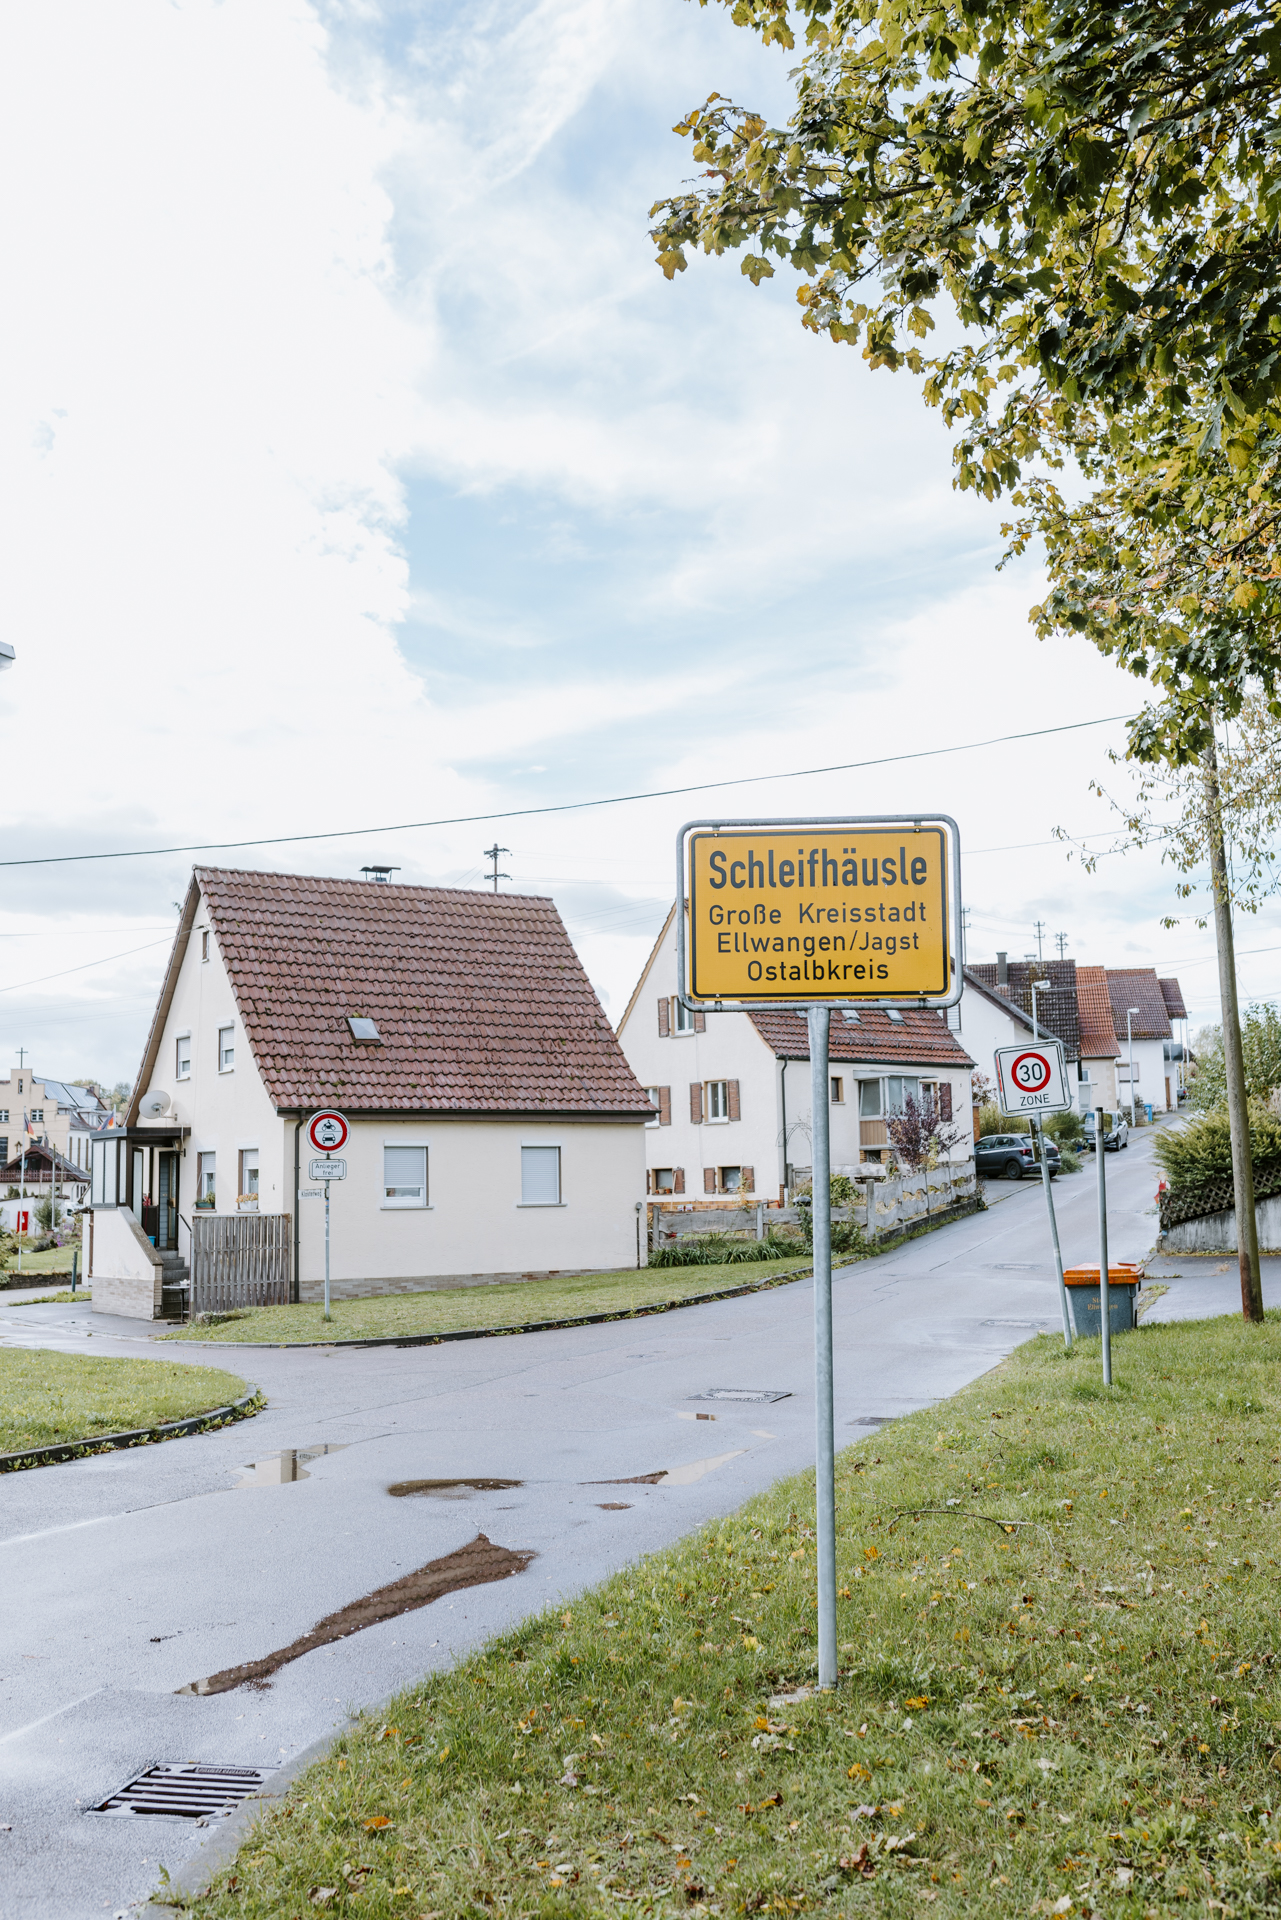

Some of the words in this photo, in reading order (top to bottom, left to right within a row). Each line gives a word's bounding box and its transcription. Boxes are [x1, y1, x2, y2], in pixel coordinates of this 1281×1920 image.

[709, 846, 927, 889] Schleifhäusle
[709, 904, 782, 925] Große
[799, 901, 926, 924] Kreisstadt
[717, 930, 919, 957] Ellwangen/Jagst
[747, 959, 889, 982] Ostalbkreis
[1019, 1063, 1042, 1082] 30
[1020, 1093, 1050, 1106] ZONE
